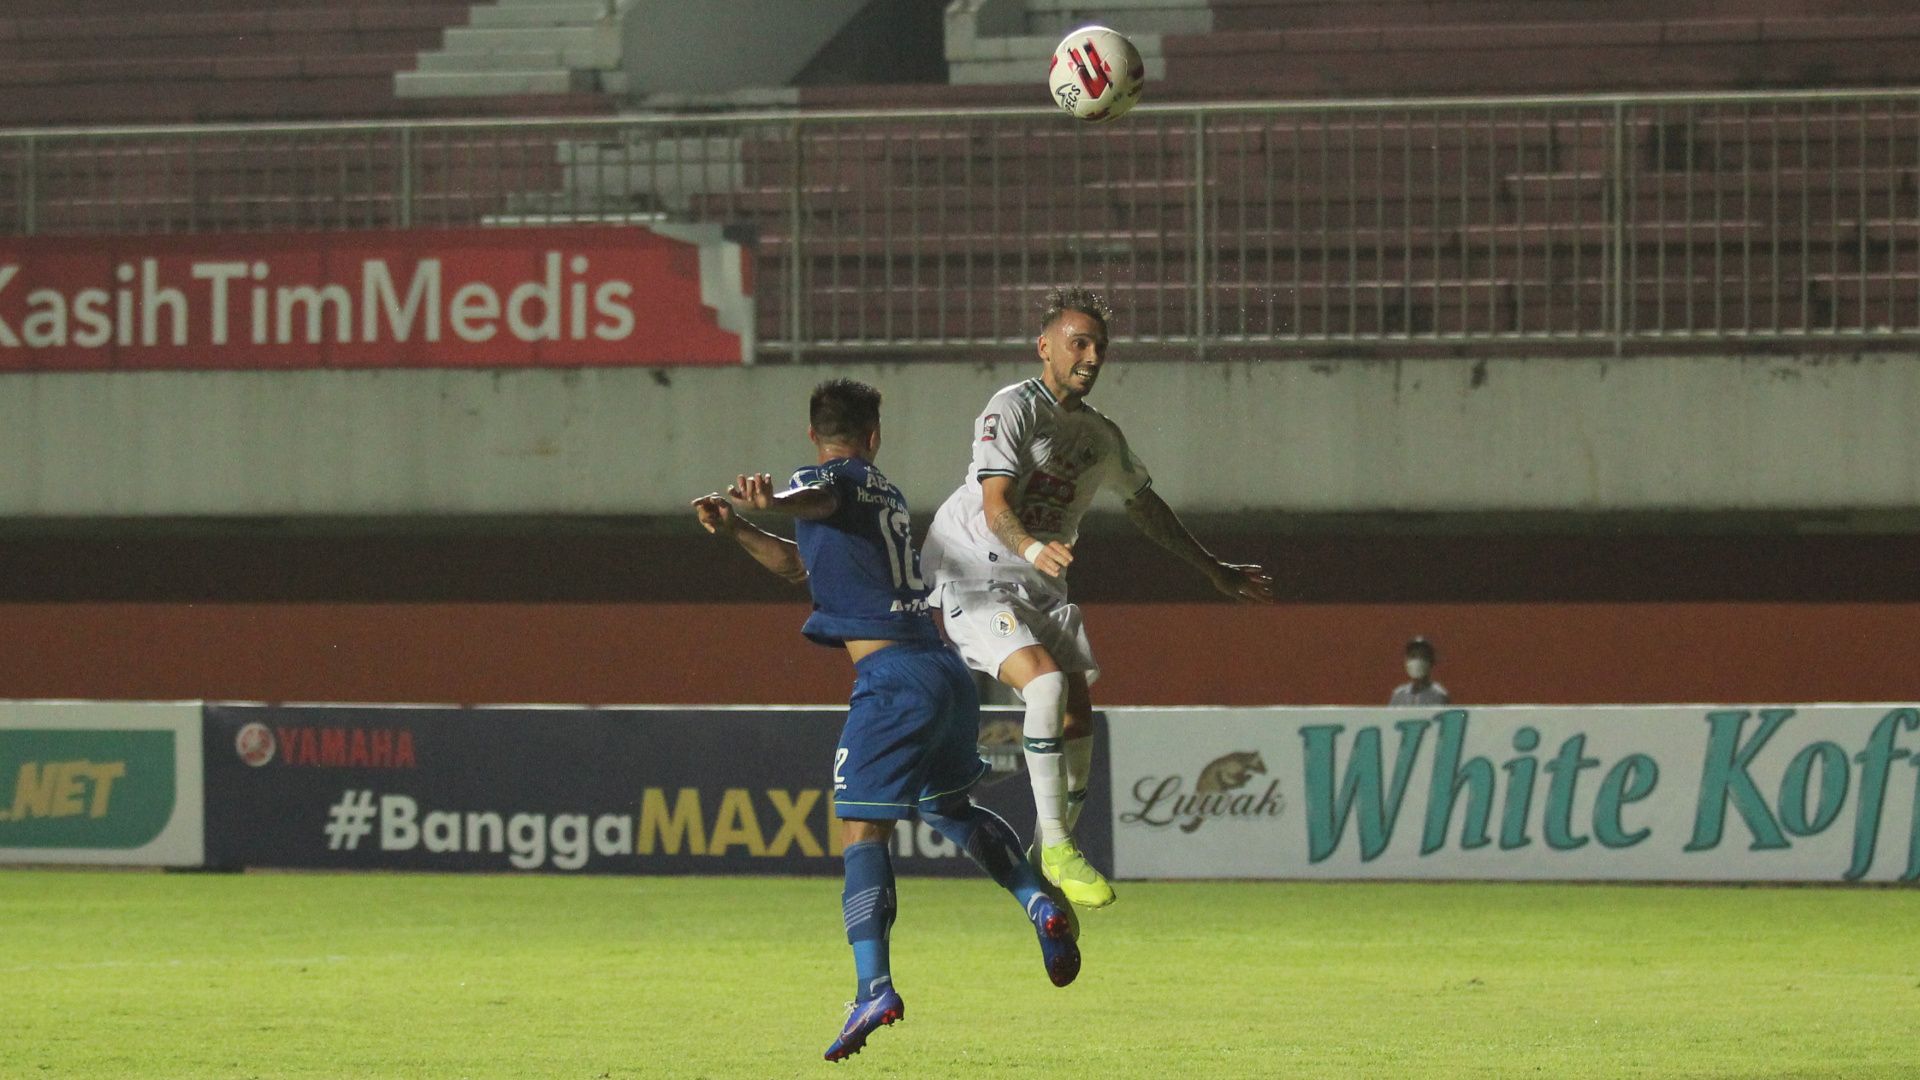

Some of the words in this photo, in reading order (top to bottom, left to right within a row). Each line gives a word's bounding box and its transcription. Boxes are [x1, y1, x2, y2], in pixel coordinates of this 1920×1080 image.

[278, 726, 416, 768] YAMAHA
[1119, 776, 1286, 827] Luwak
[1298, 708, 1660, 865] White
